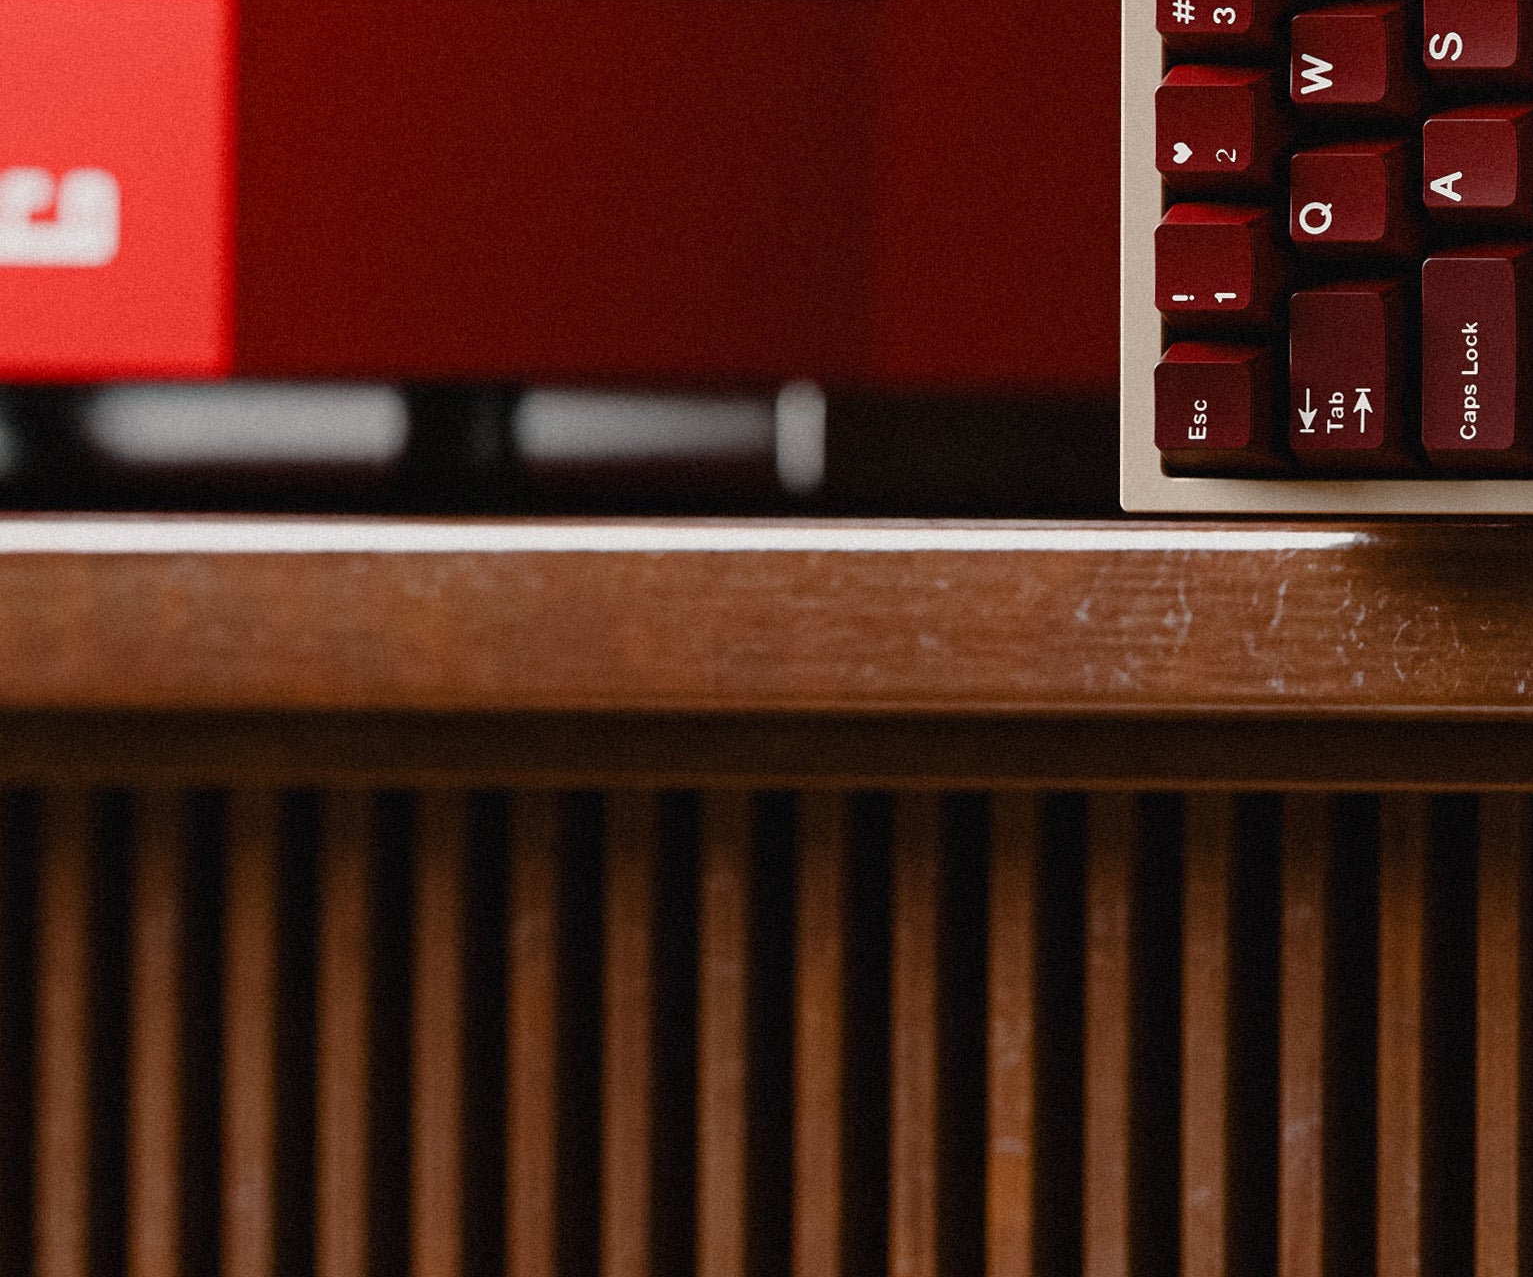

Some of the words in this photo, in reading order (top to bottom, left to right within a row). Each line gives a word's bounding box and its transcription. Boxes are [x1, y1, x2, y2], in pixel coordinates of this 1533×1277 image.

[1212, 7, 1237, 25] 3
[1428, 31, 1463, 62] S
[1300, 53, 1334, 95] W
[1215, 148, 1237, 163] 2
[1429, 171, 1463, 202] A
[1298, 201, 1333, 235] Q
[1214, 292, 1237, 304] 1
[1461, 321, 1479, 376] Lock
[1187, 399, 1208, 440] Esc
[1326, 391, 1345, 434] Tab
[1459, 384, 1481, 440] Caps
